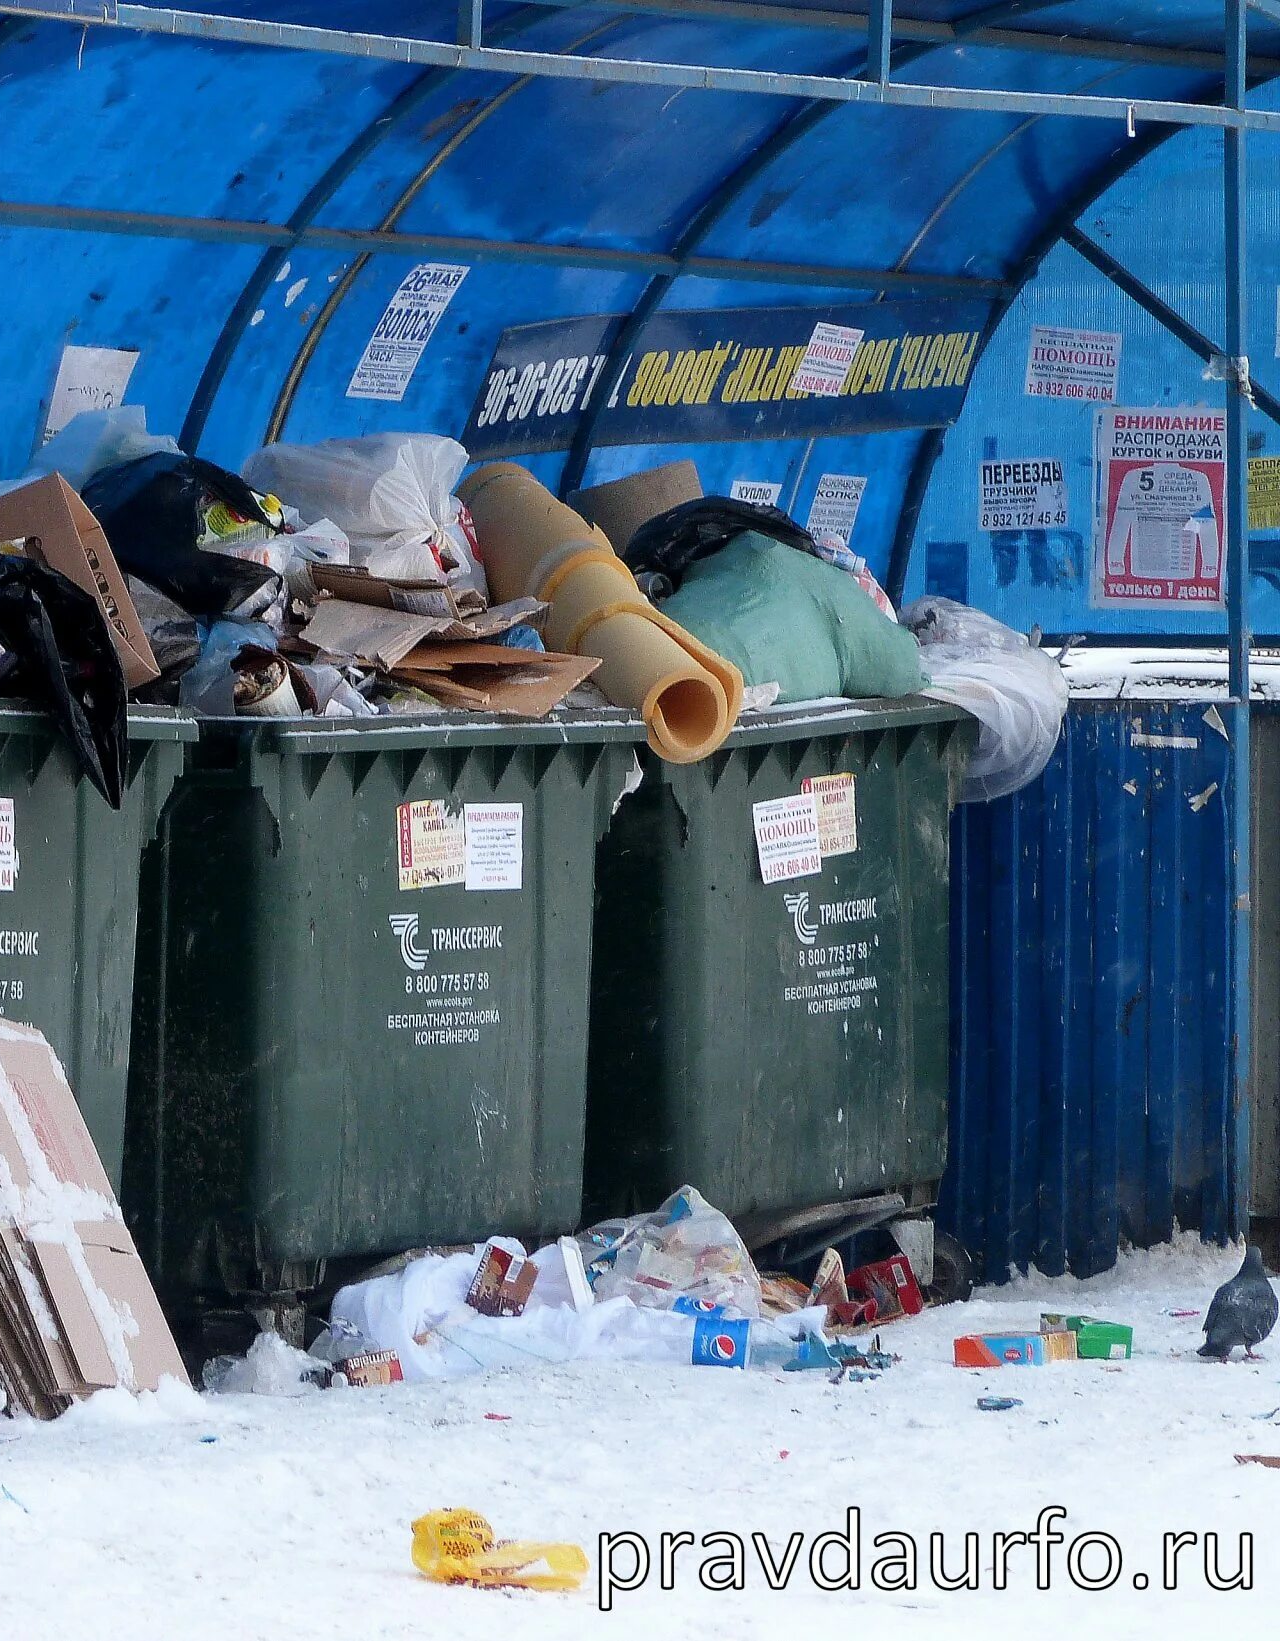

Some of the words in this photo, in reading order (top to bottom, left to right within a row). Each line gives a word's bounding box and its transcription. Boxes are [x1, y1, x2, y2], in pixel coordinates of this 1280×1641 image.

[400, 271, 430, 292] 26
[428, 272, 463, 287] МАЯ
[374, 307, 442, 341] ВОЛОСЫ
[806, 343, 852, 362] ПОМОЩЬ
[1033, 347, 1116, 369] ПОМОЩЬ
[1045, 382, 1063, 396] 932
[1066, 384, 1084, 397] 606
[1086, 386, 1098, 399] 40
[1101, 386, 1113, 400] 04
[1114, 415, 1224, 431] ВНИМАНИЕ
[1115, 432, 1221, 448] РАСПРОДАЖА
[1112, 447, 1161, 458] КУРТОК
[1166, 450, 1174, 459] и
[1178, 449, 1223, 460] ОБУВИ
[982, 461, 1063, 486] ПЕРЕЕЗДЫ
[1139, 471, 1154, 491] 5
[738, 486, 772, 500] КУПЛЮ
[816, 489, 860, 501] КОПКА
[983, 485, 1038, 497] ГРУЗЧИКИ
[982, 513, 989, 526] 8
[992, 513, 1013, 526] 932
[1016, 512, 1035, 525] 121
[1038, 511, 1051, 524] 45
[1053, 510, 1067, 524] 45
[1108, 583, 1162, 596] только
[1167, 581, 1174, 596] 1
[758, 818, 816, 843] ПОМОЩЬ
[819, 897, 877, 925] ТРАНССЕРВИС
[431, 925, 503, 951] ТРАНССЕРВИС
[799, 950, 805, 967] 8
[808, 947, 826, 966] 800
[828, 945, 845, 964] 775
[846, 943, 856, 961] 57
[858, 941, 867, 959] 58
[10, 981, 24, 1000] 58
[405, 975, 413, 994] 8
[416, 975, 438, 993] 800
[440, 974, 461, 993] 775
[463, 973, 476, 992] 57
[477, 971, 490, 991] 58
[785, 982, 839, 1001] БЕСПЛАТНАЯ
[839, 976, 878, 994] УСТАНОВКА
[807, 994, 861, 1015] КОНТЕЙНЕРОВ
[387, 1012, 453, 1029] БЕСПЛАТНАЯ
[454, 1009, 500, 1026] УСТАНОВКА
[415, 1027, 480, 1045] КОНТЕЙНЕРОВ
[347, 1348, 398, 1371] parmalat
